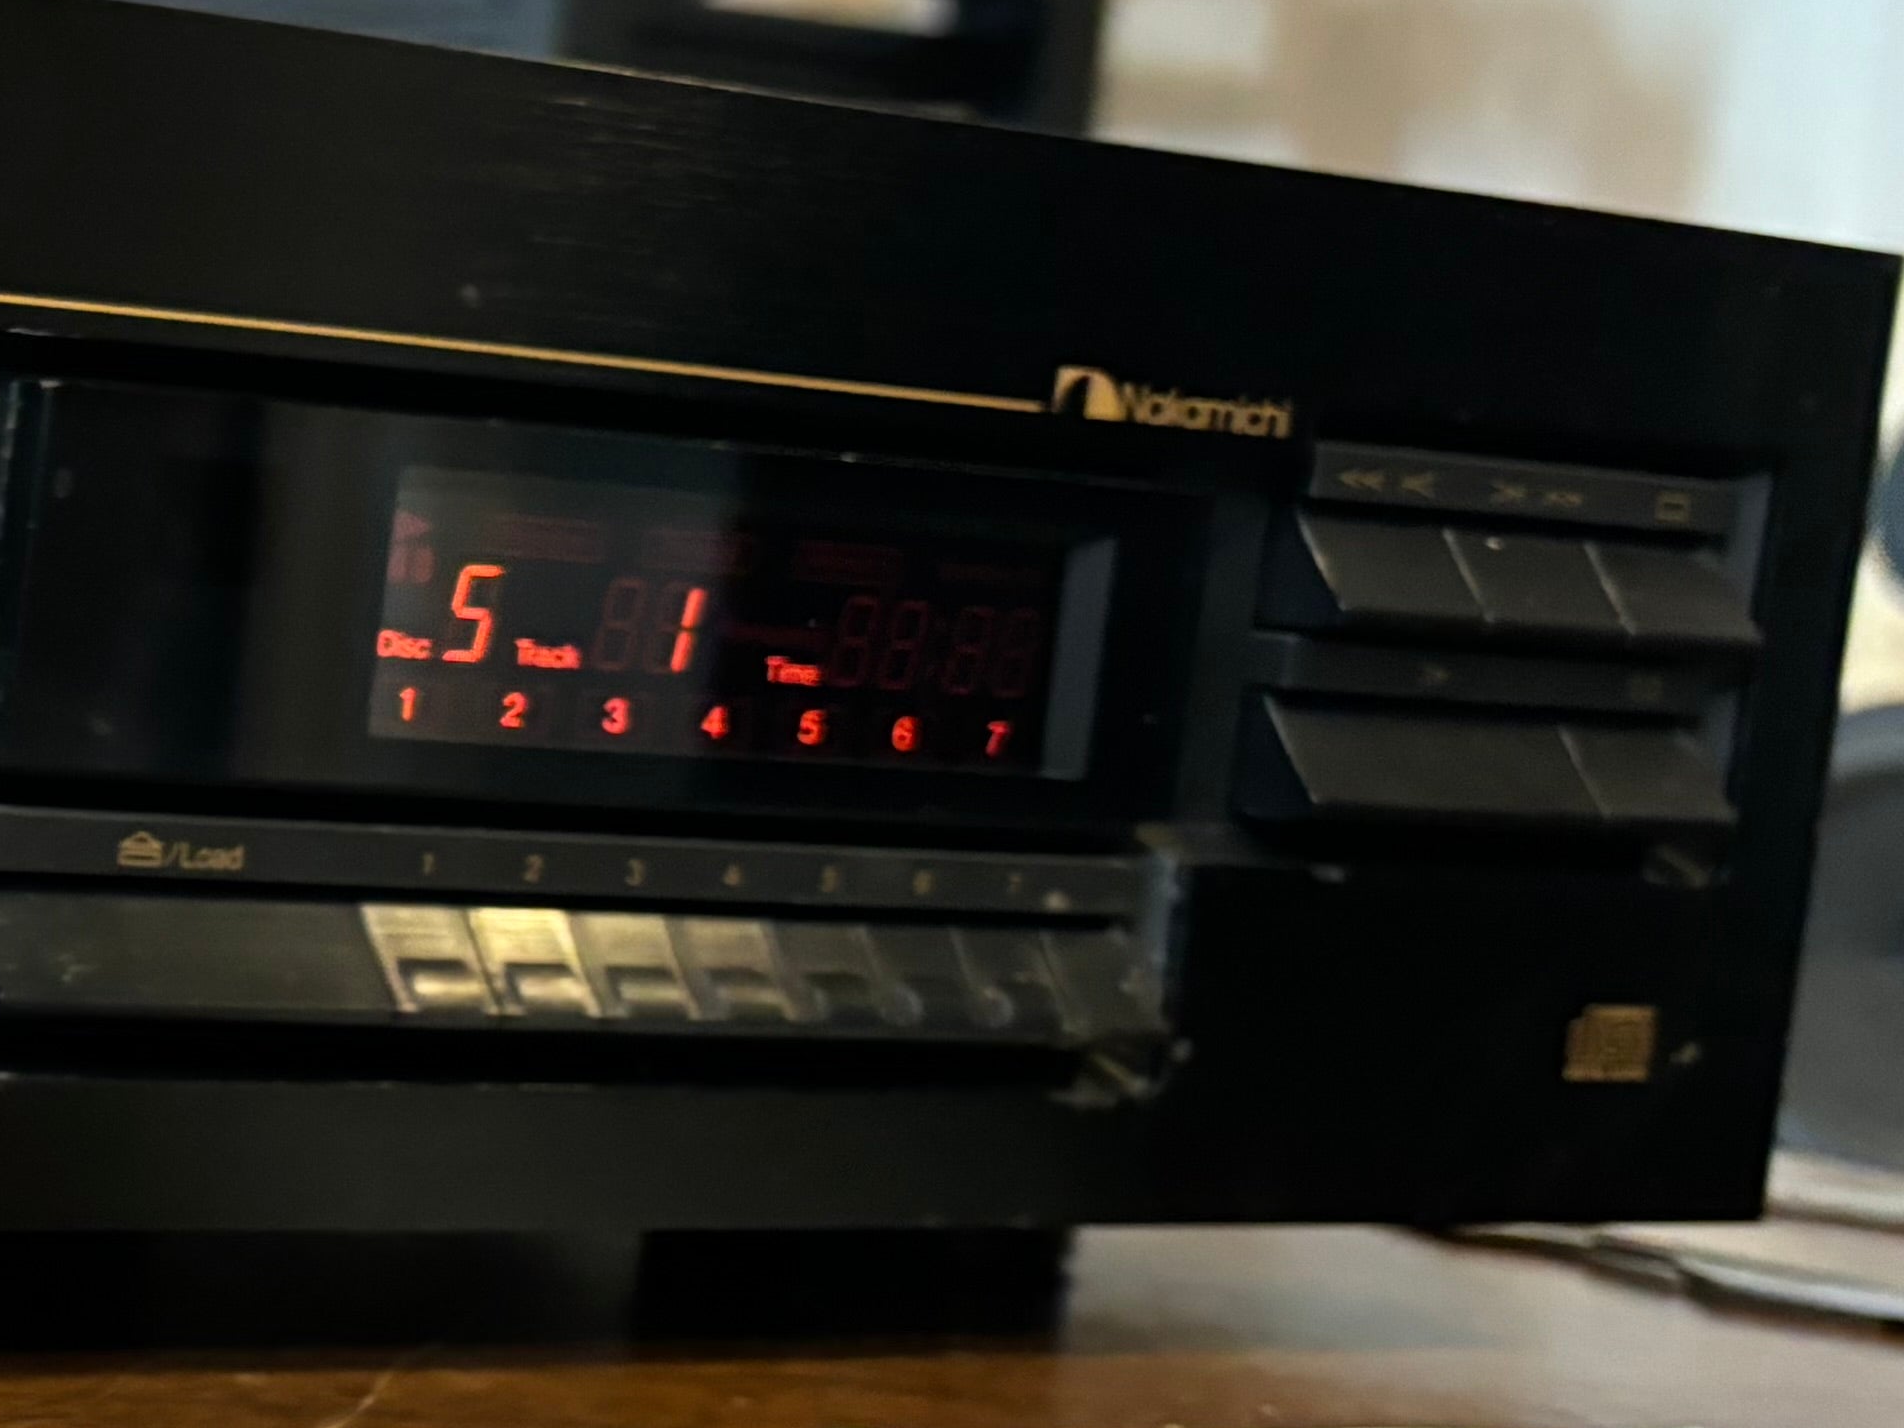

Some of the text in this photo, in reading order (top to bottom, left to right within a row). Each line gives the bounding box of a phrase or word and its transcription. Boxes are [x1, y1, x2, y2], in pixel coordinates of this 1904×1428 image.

[1120, 379, 1295, 440] Nakamichi
[377, 629, 432, 659] Disc
[670, 587, 708, 673] 1
[399, 686, 1014, 757] 1 2 3 4 5 6 7
